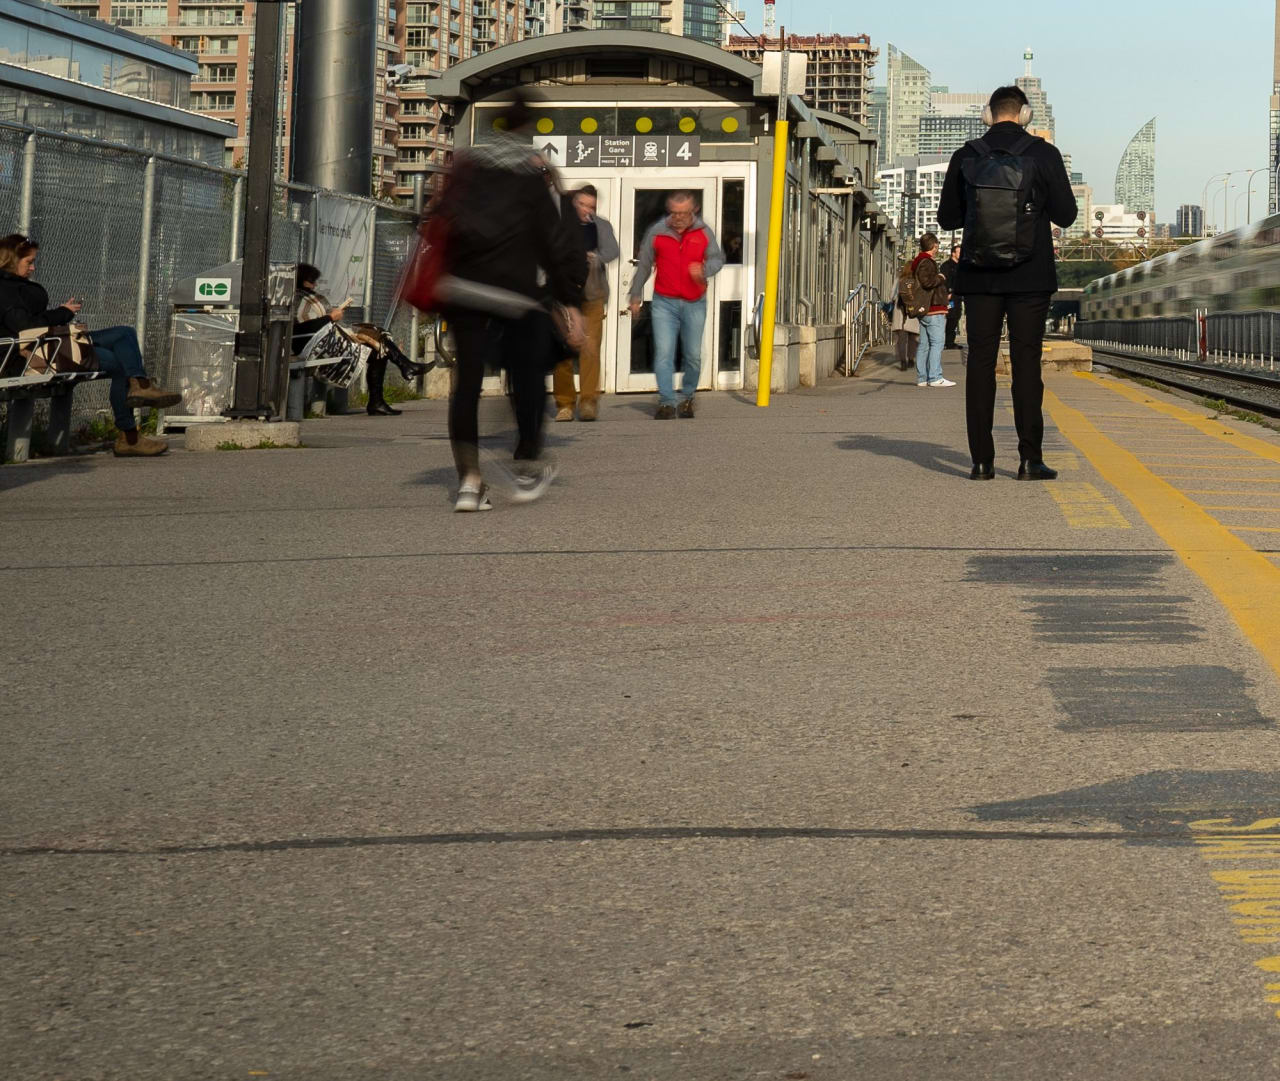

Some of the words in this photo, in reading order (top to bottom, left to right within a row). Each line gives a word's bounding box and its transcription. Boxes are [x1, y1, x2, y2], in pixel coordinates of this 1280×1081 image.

[760, 112, 769, 132] 1
[676, 141, 692, 161] 4
[199, 282, 228, 296] GO
